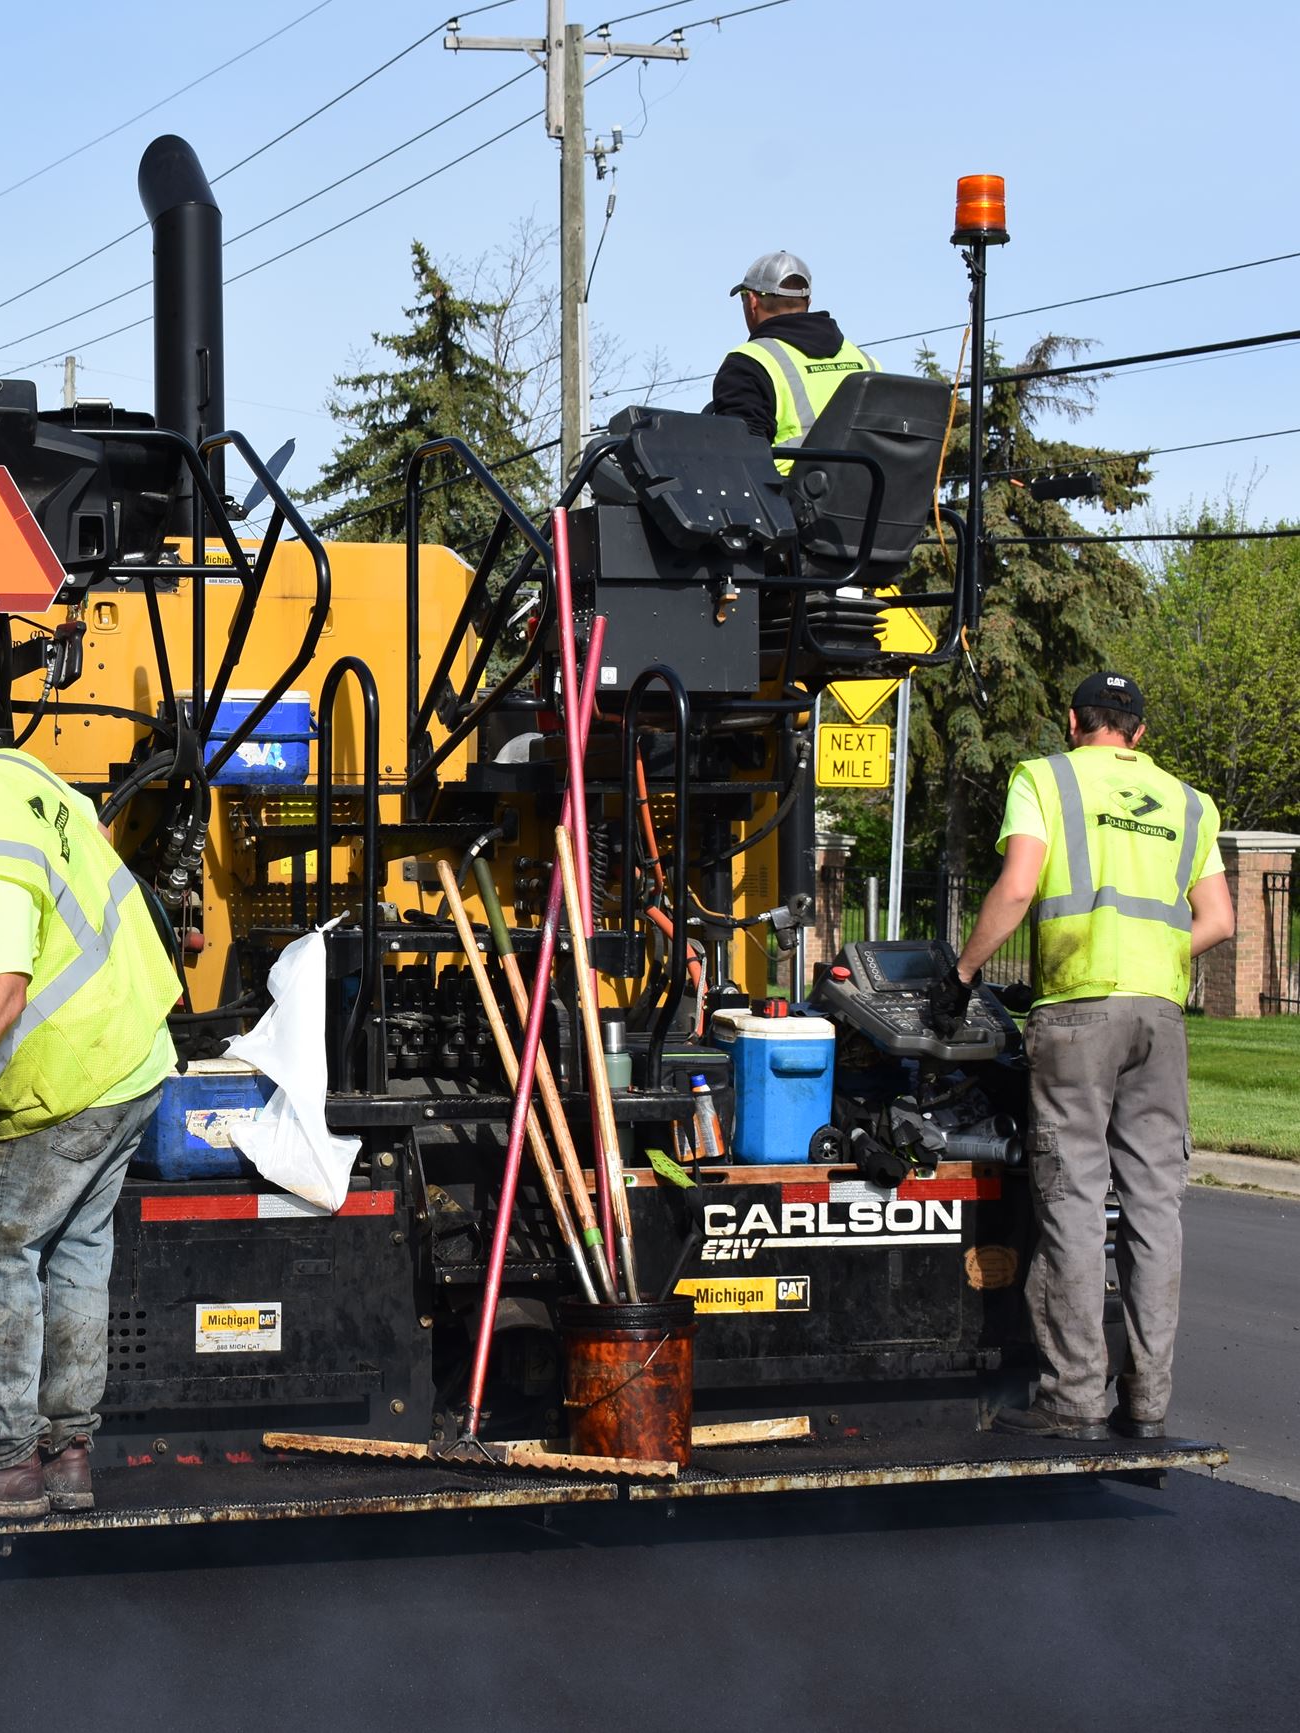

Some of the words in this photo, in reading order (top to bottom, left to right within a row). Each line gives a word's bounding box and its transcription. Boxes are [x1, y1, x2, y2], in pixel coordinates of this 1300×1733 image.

[205, 555, 233, 564] Michig
[245, 556, 255, 566] AT
[1106, 676, 1127, 688] CAT
[831, 733, 876, 751] NEXT
[832, 760, 872, 778] MILE
[1104, 815, 1136, 830] PO-LINE
[703, 1200, 962, 1236] CARLSON
[700, 1238, 762, 1260] EZIV
[695, 1287, 764, 1305] Michigan
[777, 1281, 806, 1301] CAT
[208, 1314, 255, 1327] Michigan
[259, 1313, 275, 1325] CAT
